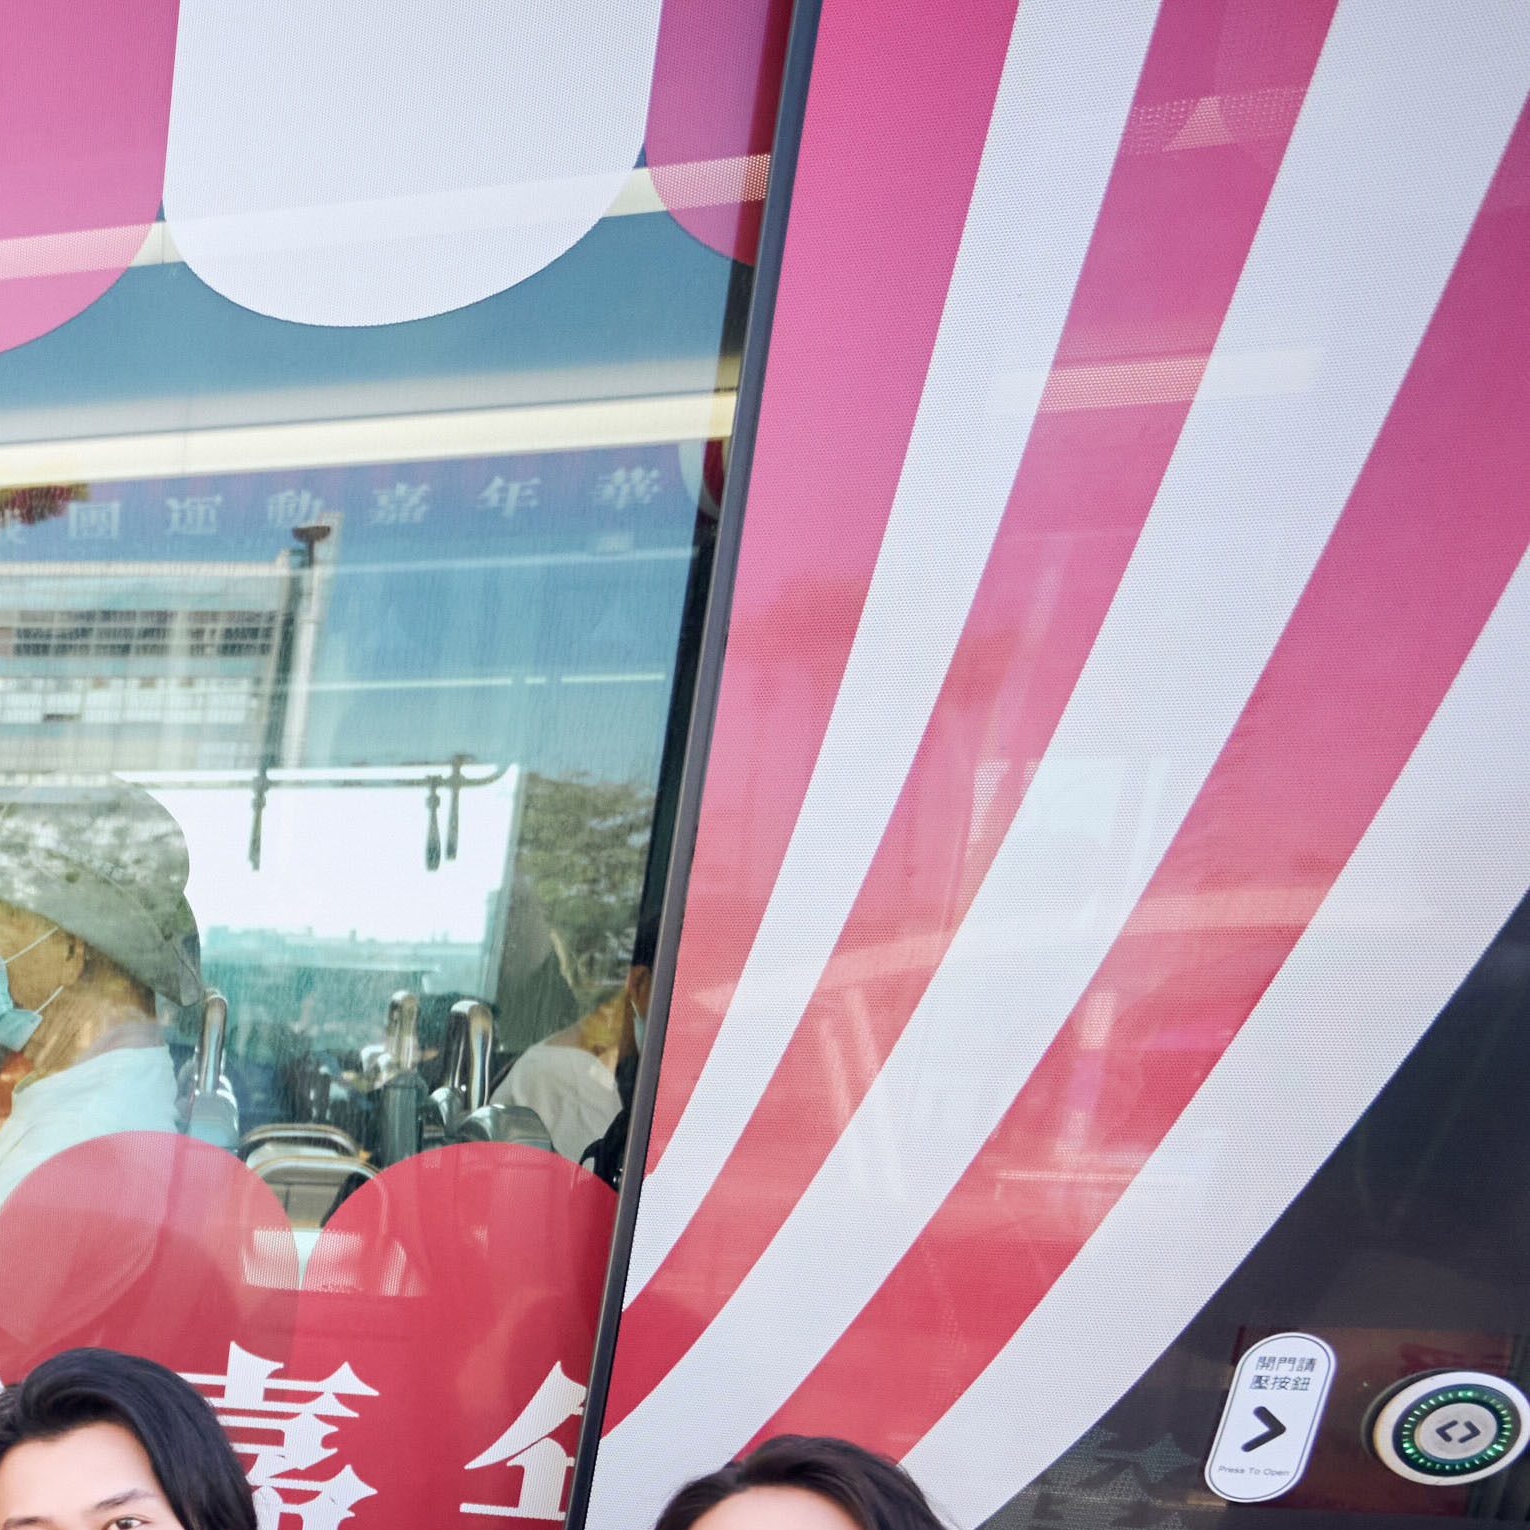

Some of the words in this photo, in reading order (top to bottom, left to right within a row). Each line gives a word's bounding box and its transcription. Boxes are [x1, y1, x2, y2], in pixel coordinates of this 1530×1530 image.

[1255, 1355, 1318, 1372] 開門請
[1218, 1465, 1245, 1475] Press
[1248, 1467, 1261, 1476] To
[1263, 1468, 1290, 1477] Open
